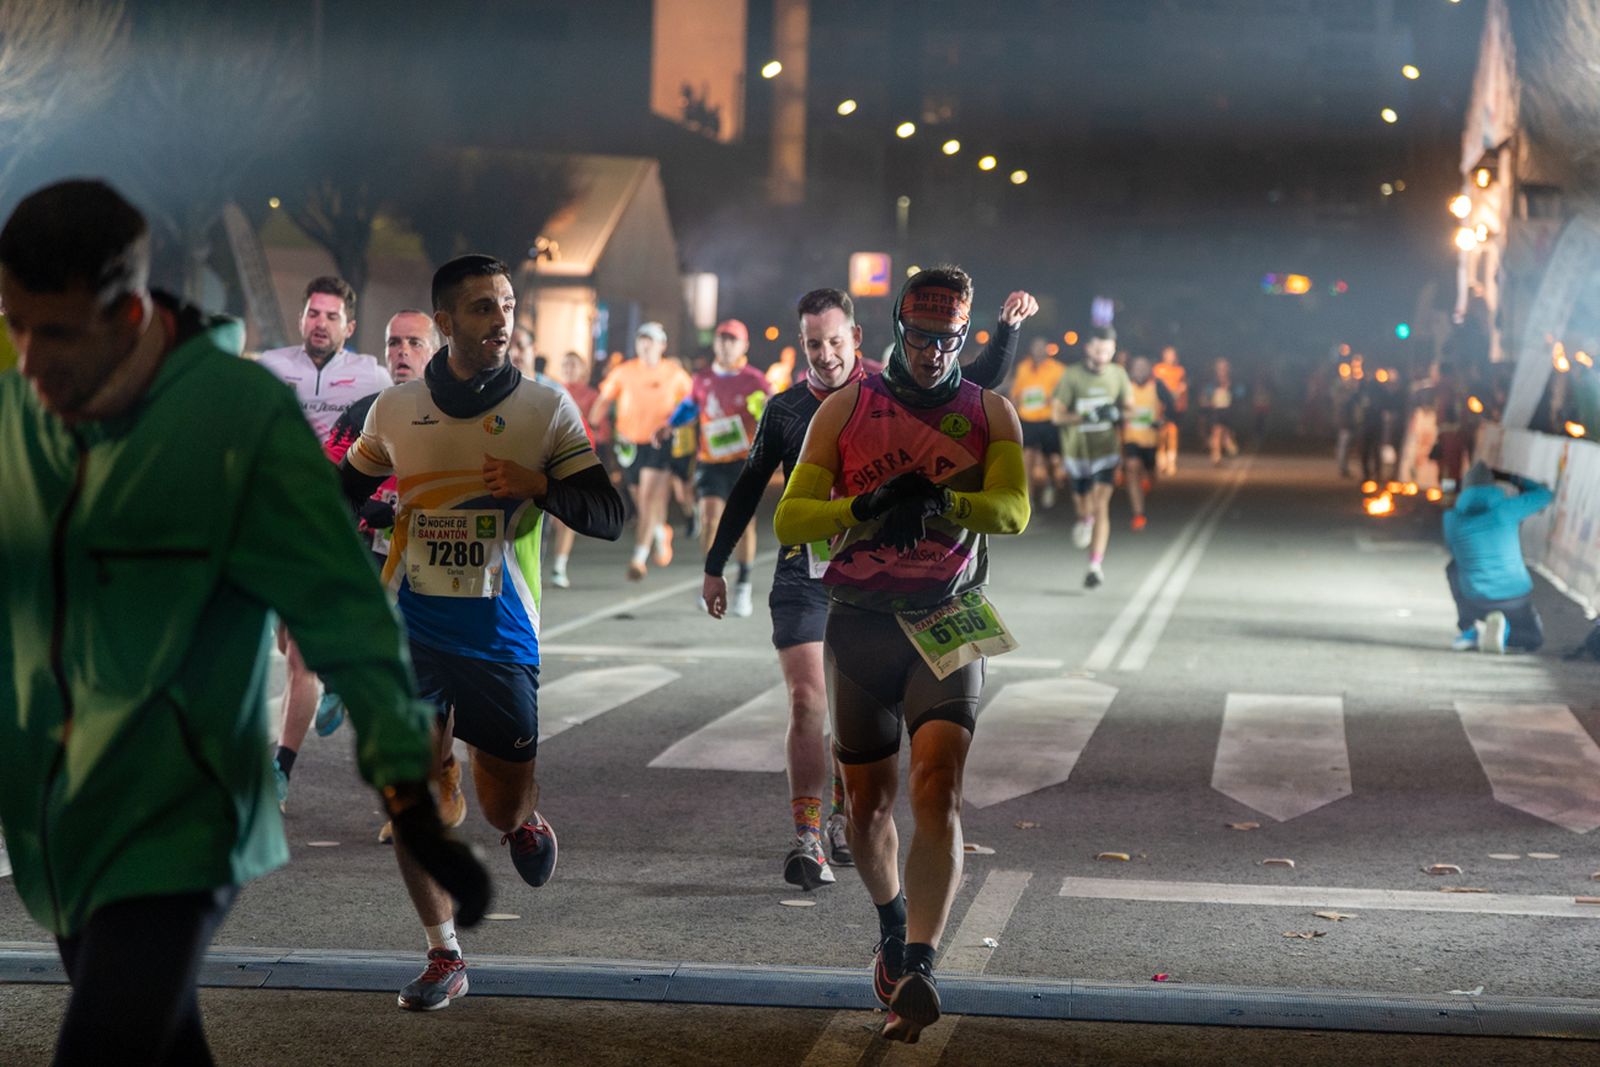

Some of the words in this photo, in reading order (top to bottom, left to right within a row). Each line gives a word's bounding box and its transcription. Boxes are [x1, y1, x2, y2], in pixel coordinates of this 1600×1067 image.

[851, 448, 913, 490] SIERRA
[428, 519, 455, 528] NOCHE
[456, 519, 468, 529] DE
[418, 529, 436, 540] SAN
[427, 541, 484, 567] 7280
[914, 617, 934, 632] SAN
[929, 607, 988, 645] 6156
